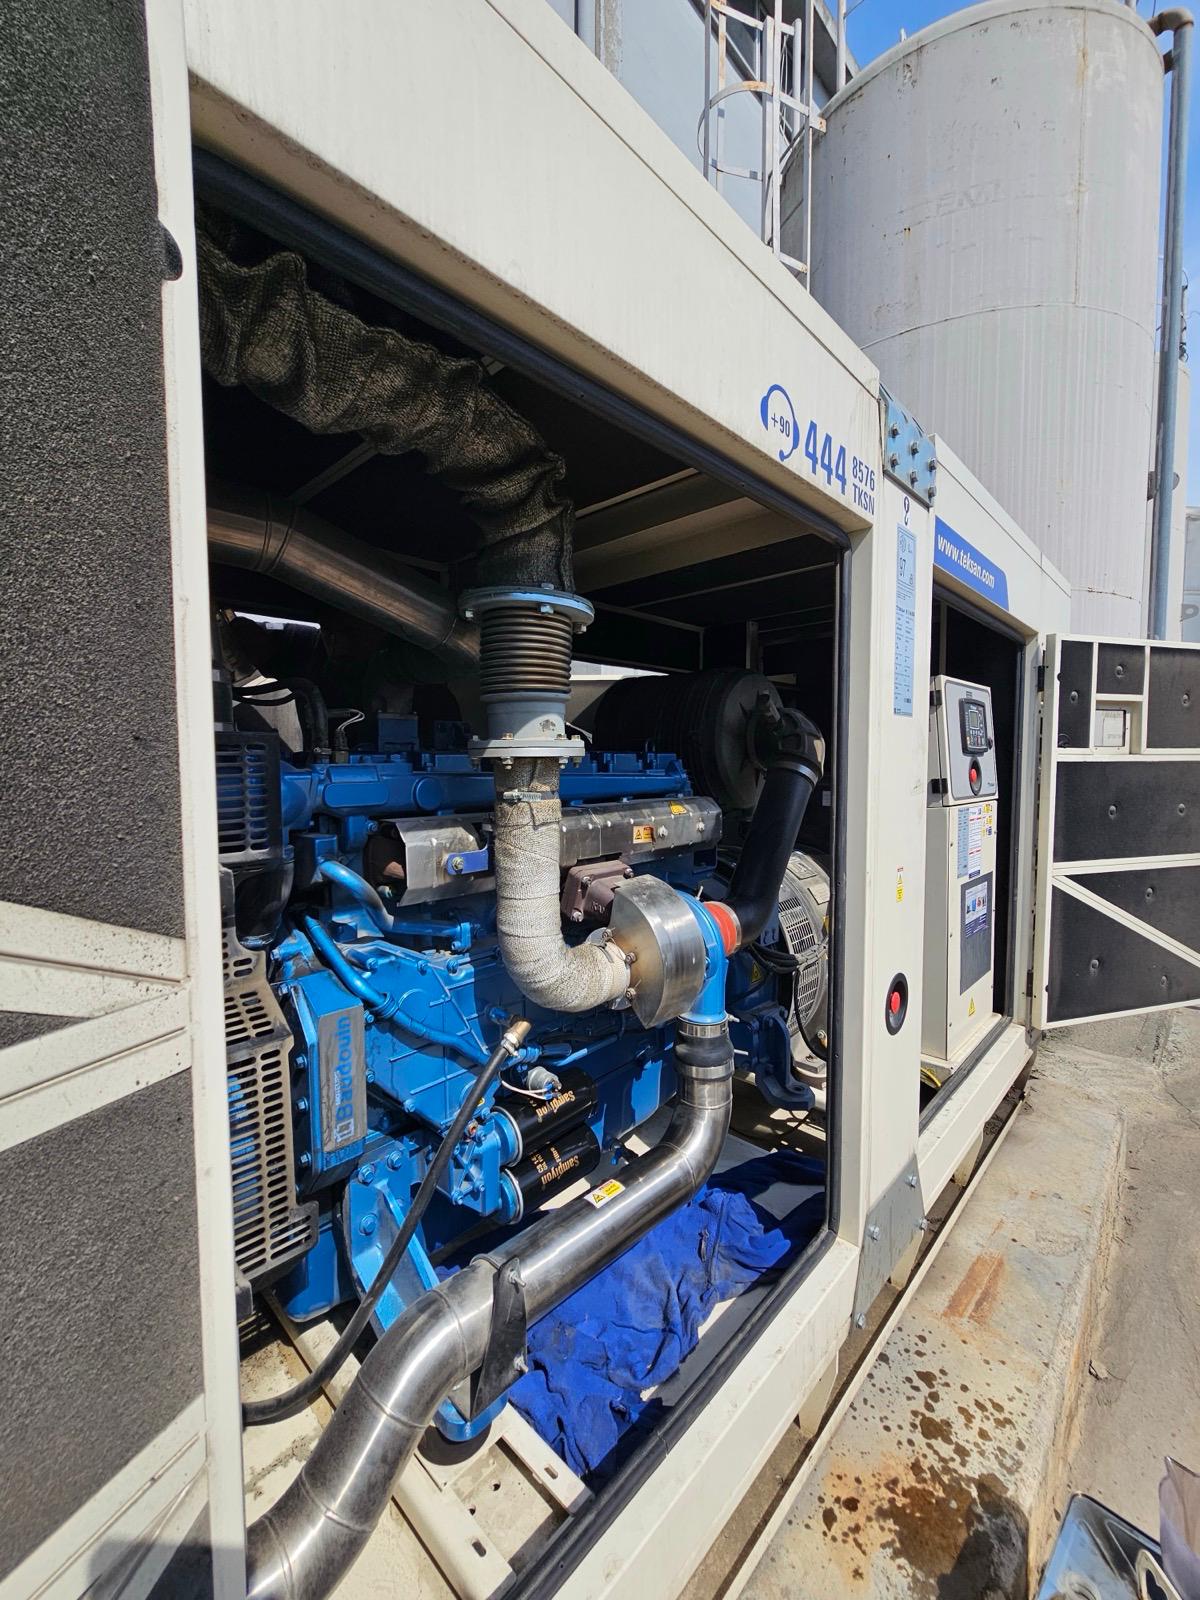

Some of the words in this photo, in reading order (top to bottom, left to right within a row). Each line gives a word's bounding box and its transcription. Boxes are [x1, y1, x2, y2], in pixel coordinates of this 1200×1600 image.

[771, 413, 791, 438] +90
[805, 420, 847, 496] 444
[852, 455, 876, 492] 8576
[852, 483, 875, 516] TKSN
[937, 534, 995, 589] www.teksan.com
[336, 1015, 353, 1120] Baudouin
